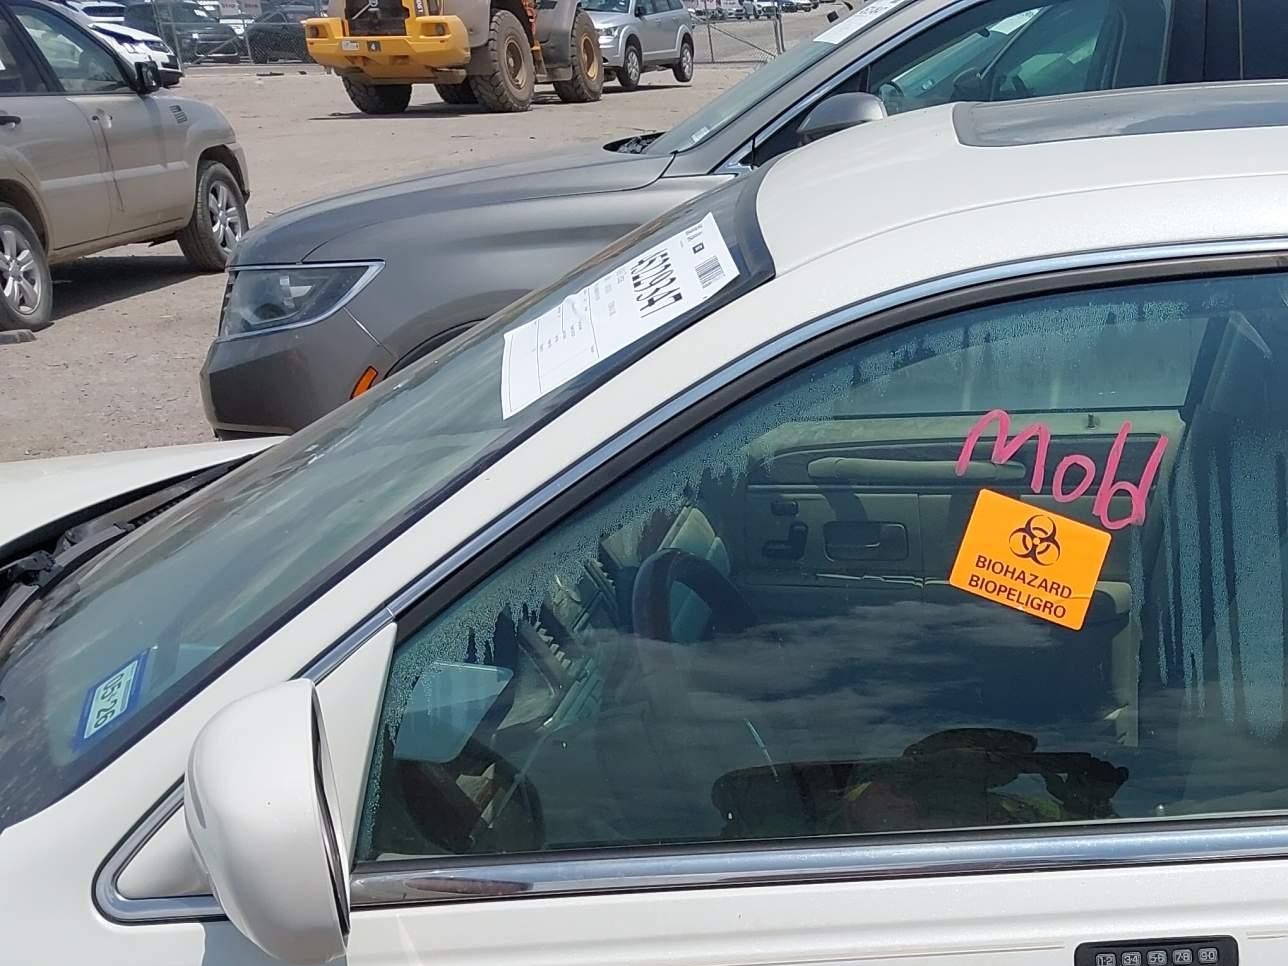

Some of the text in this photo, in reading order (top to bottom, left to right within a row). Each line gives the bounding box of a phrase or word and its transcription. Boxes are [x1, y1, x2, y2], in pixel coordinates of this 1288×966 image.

[630, 248, 683, 318] 45229347
[967, 574, 1067, 619] BIOPELIGRO
[975, 554, 1072, 600] BIOHAZARD
